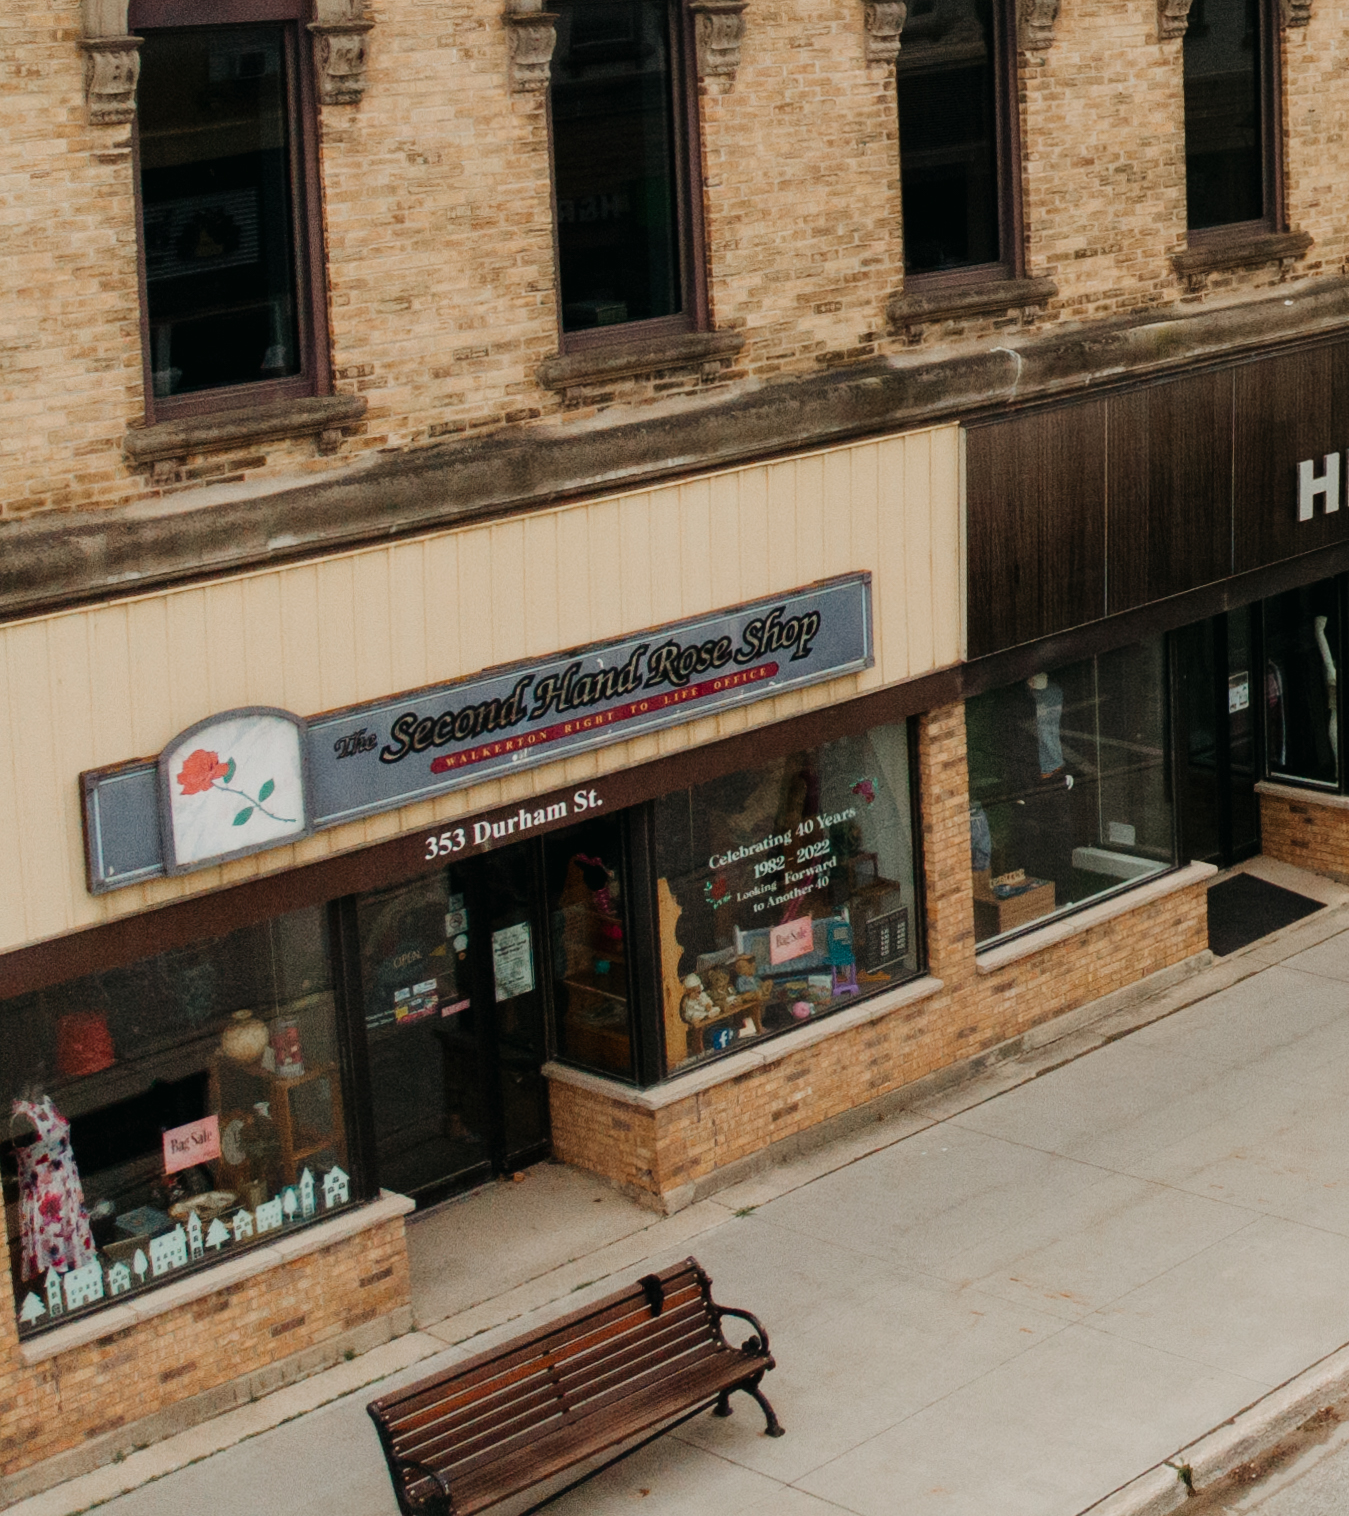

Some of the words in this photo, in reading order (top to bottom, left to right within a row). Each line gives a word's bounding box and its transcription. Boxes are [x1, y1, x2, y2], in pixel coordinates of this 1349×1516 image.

[334, 728, 378, 759] The
[379, 674, 536, 764] Second
[527, 643, 650, 722] Hand
[643, 636, 733, 690] Rose
[733, 605, 822, 663] Shop
[446, 731, 548, 767] WALKERTON
[564, 712, 615, 734] RIGHT
[630, 702, 648, 715] TO
[664, 687, 699, 706] LIFE
[713, 666, 768, 690] OFFICE
[425, 827, 466, 860] 353
[473, 798, 568, 845] Durham
[573, 788, 603, 813] St.
[708, 829, 793, 870] Celebrating
[795, 819, 815, 837] 40
[815, 806, 857, 830] Years
[736, 879, 778, 903] Looking
[784, 855, 837, 885] Forward
[753, 855, 786, 879] 1982
[796, 838, 831, 864] 2022
[753, 900, 766, 913] to
[767, 883, 815, 909] Another
[814, 875, 831, 890] 40
